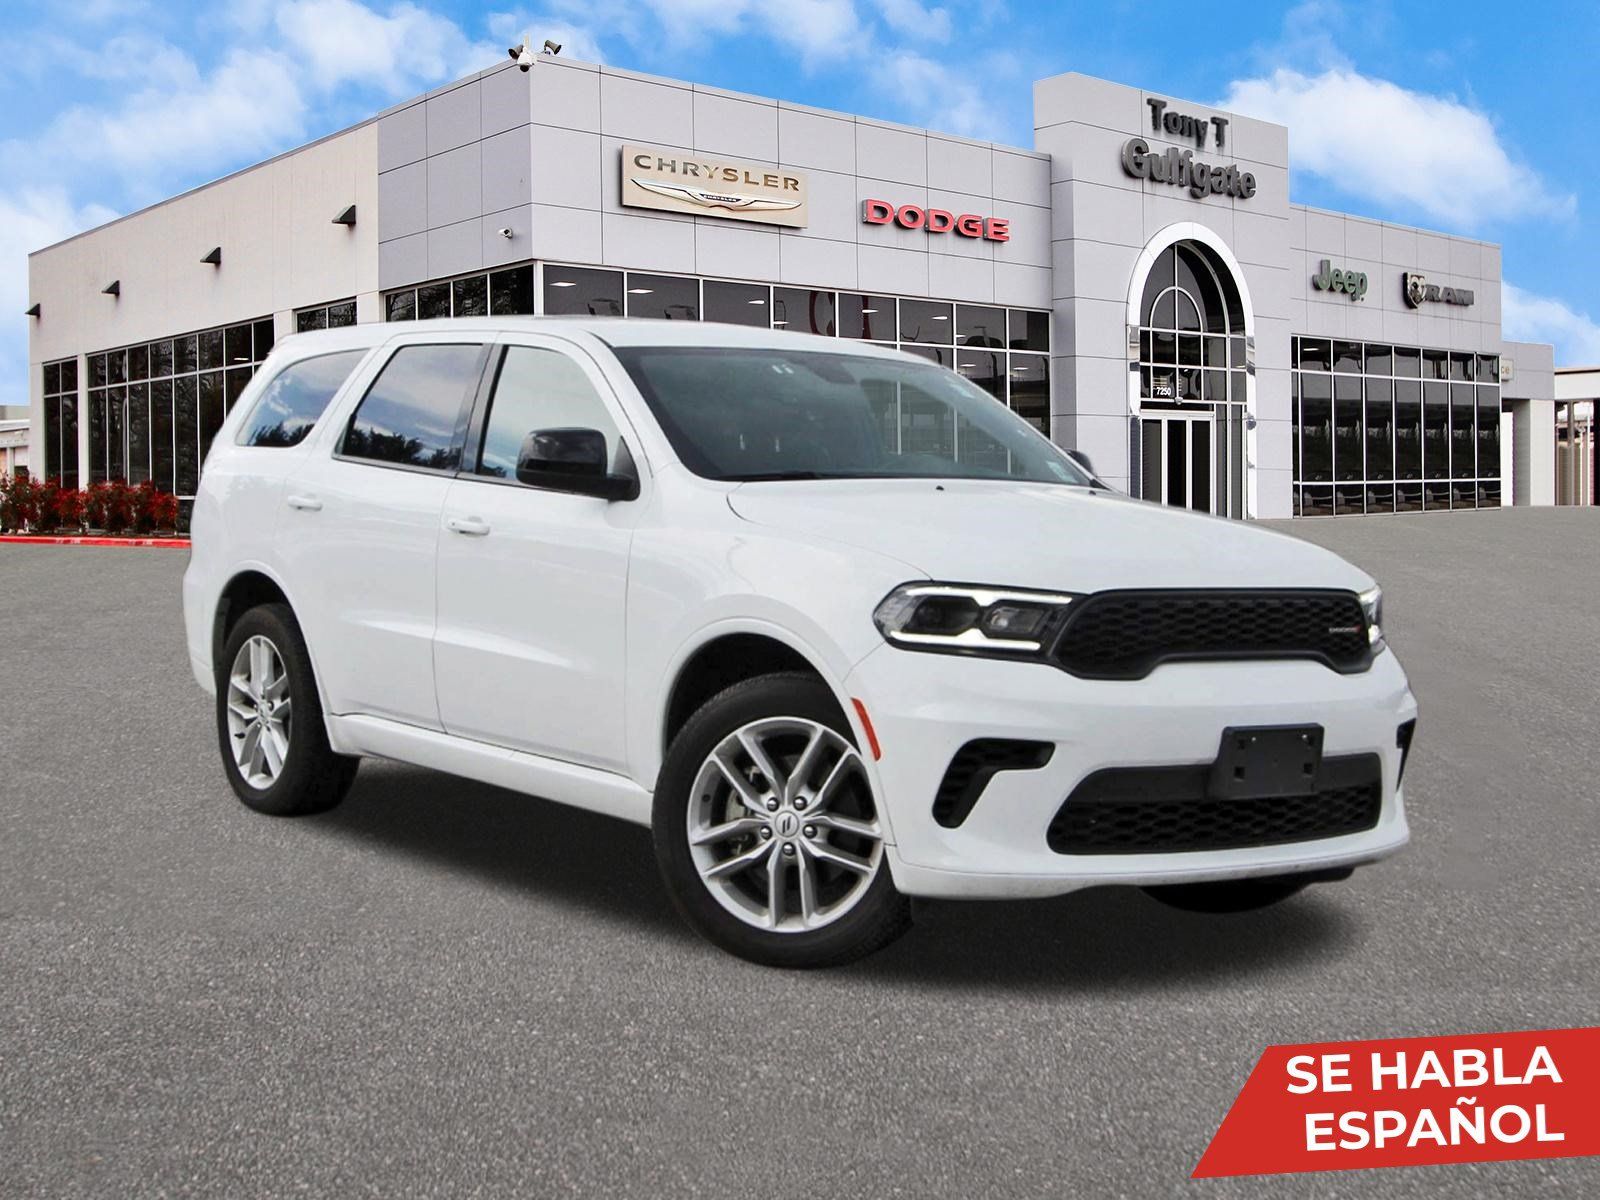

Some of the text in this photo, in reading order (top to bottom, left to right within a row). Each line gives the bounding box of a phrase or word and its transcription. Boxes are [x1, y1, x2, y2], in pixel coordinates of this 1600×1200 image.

[1147, 98, 1229, 147] Tony T
[634, 154, 800, 191] CHRYSLER
[1121, 138, 1256, 199] Gulfgate
[862, 199, 1010, 242] DODGE
[1313, 259, 1368, 301] Jeep
[1424, 284, 1474, 305] RAM
